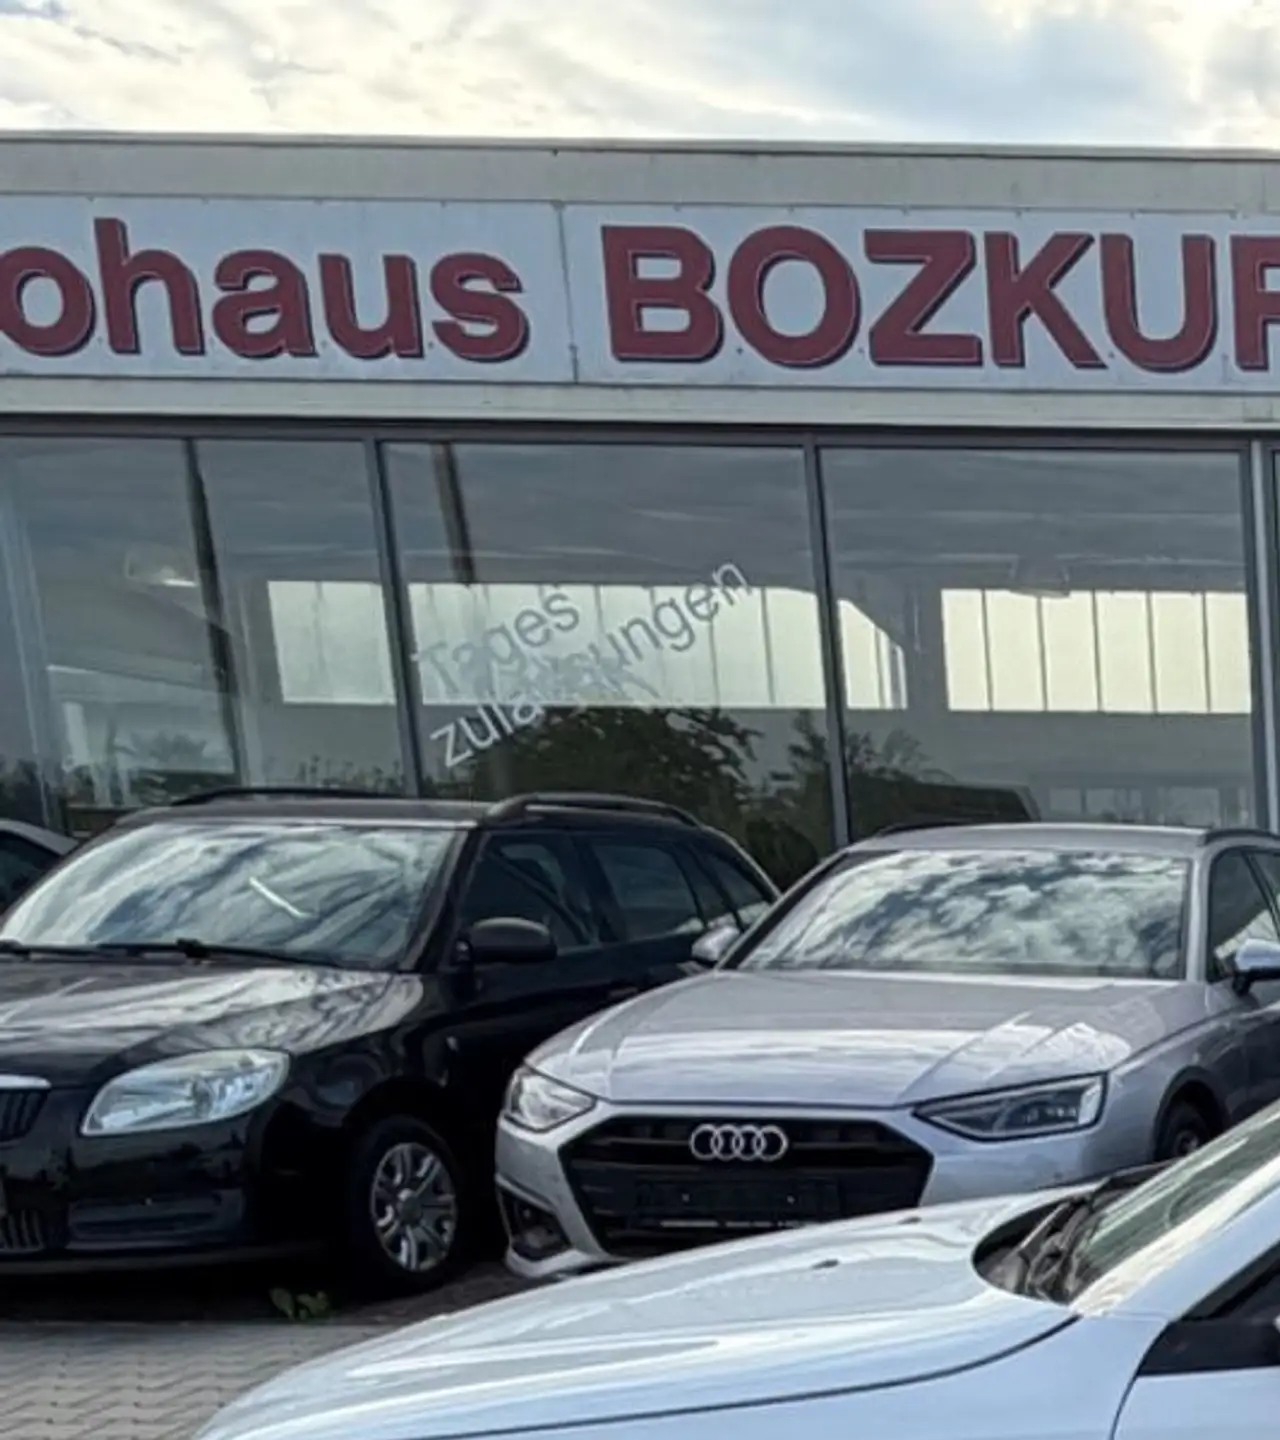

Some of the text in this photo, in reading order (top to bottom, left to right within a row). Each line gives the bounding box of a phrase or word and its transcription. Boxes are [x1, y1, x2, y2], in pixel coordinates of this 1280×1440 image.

[0, 216, 530, 363] ohaus
[410, 592, 580, 694] Tages
[430, 561, 753, 768] zulaungen
